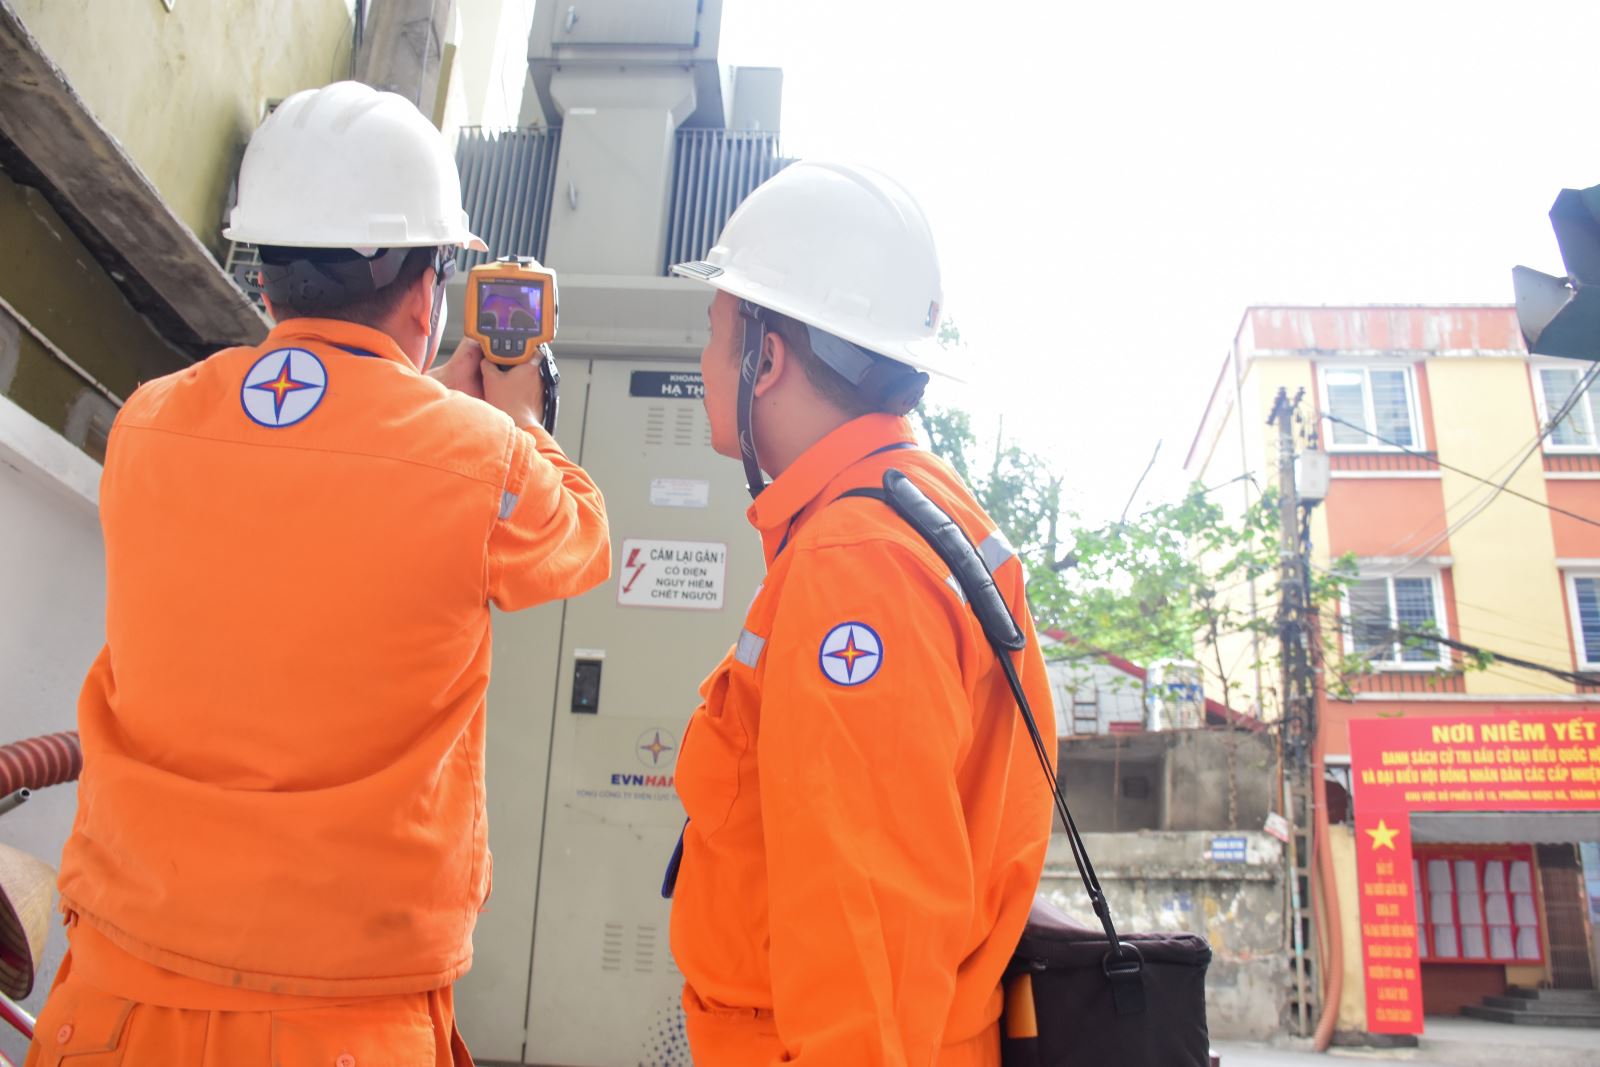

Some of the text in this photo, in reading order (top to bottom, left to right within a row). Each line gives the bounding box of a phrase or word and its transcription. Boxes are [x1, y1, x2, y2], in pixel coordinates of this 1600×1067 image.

[662, 384, 705, 396] HẠ TH
[676, 549, 693, 564] LẠI
[664, 565, 707, 576] CÓ ĐIỆN
[656, 578, 685, 587] NGUY
[1432, 717, 1597, 743] NƠI NIÊM YẾT
[1410, 748, 1439, 765] SÁCH
[1361, 768, 1376, 784] VÀ
